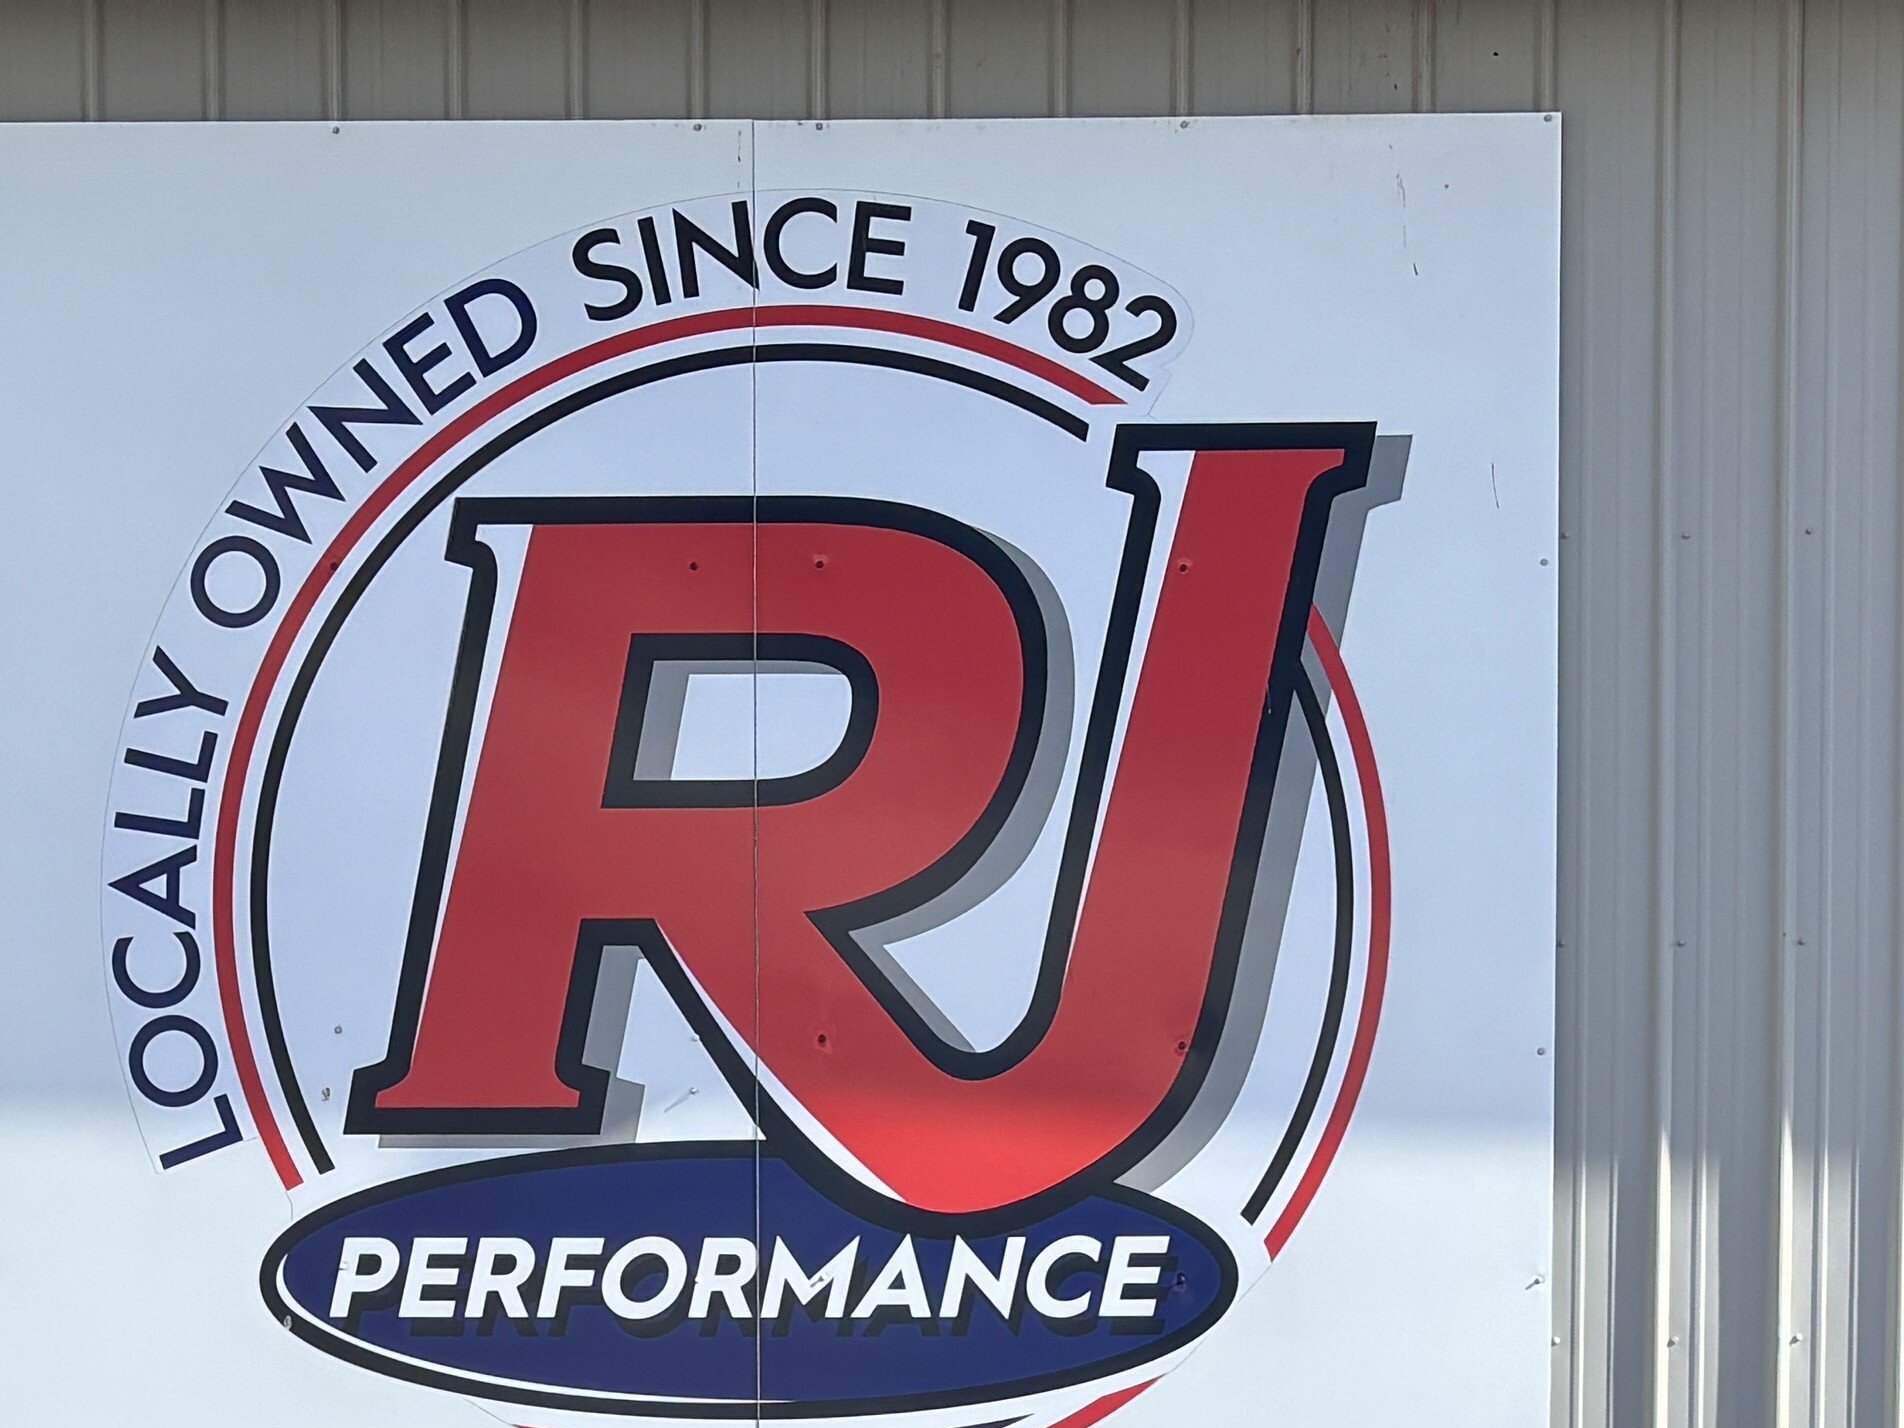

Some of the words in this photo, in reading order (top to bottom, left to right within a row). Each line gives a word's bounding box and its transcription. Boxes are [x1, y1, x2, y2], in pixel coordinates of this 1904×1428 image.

[106, 646, 245, 1171] LOCALLY
[189, 277, 539, 630] OWNED
[571, 196, 912, 322] SINCE
[958, 219, 1178, 392] 1982
[345, 421, 1371, 1229] RJ
[329, 1233, 1171, 1320] PERFORMANCE
